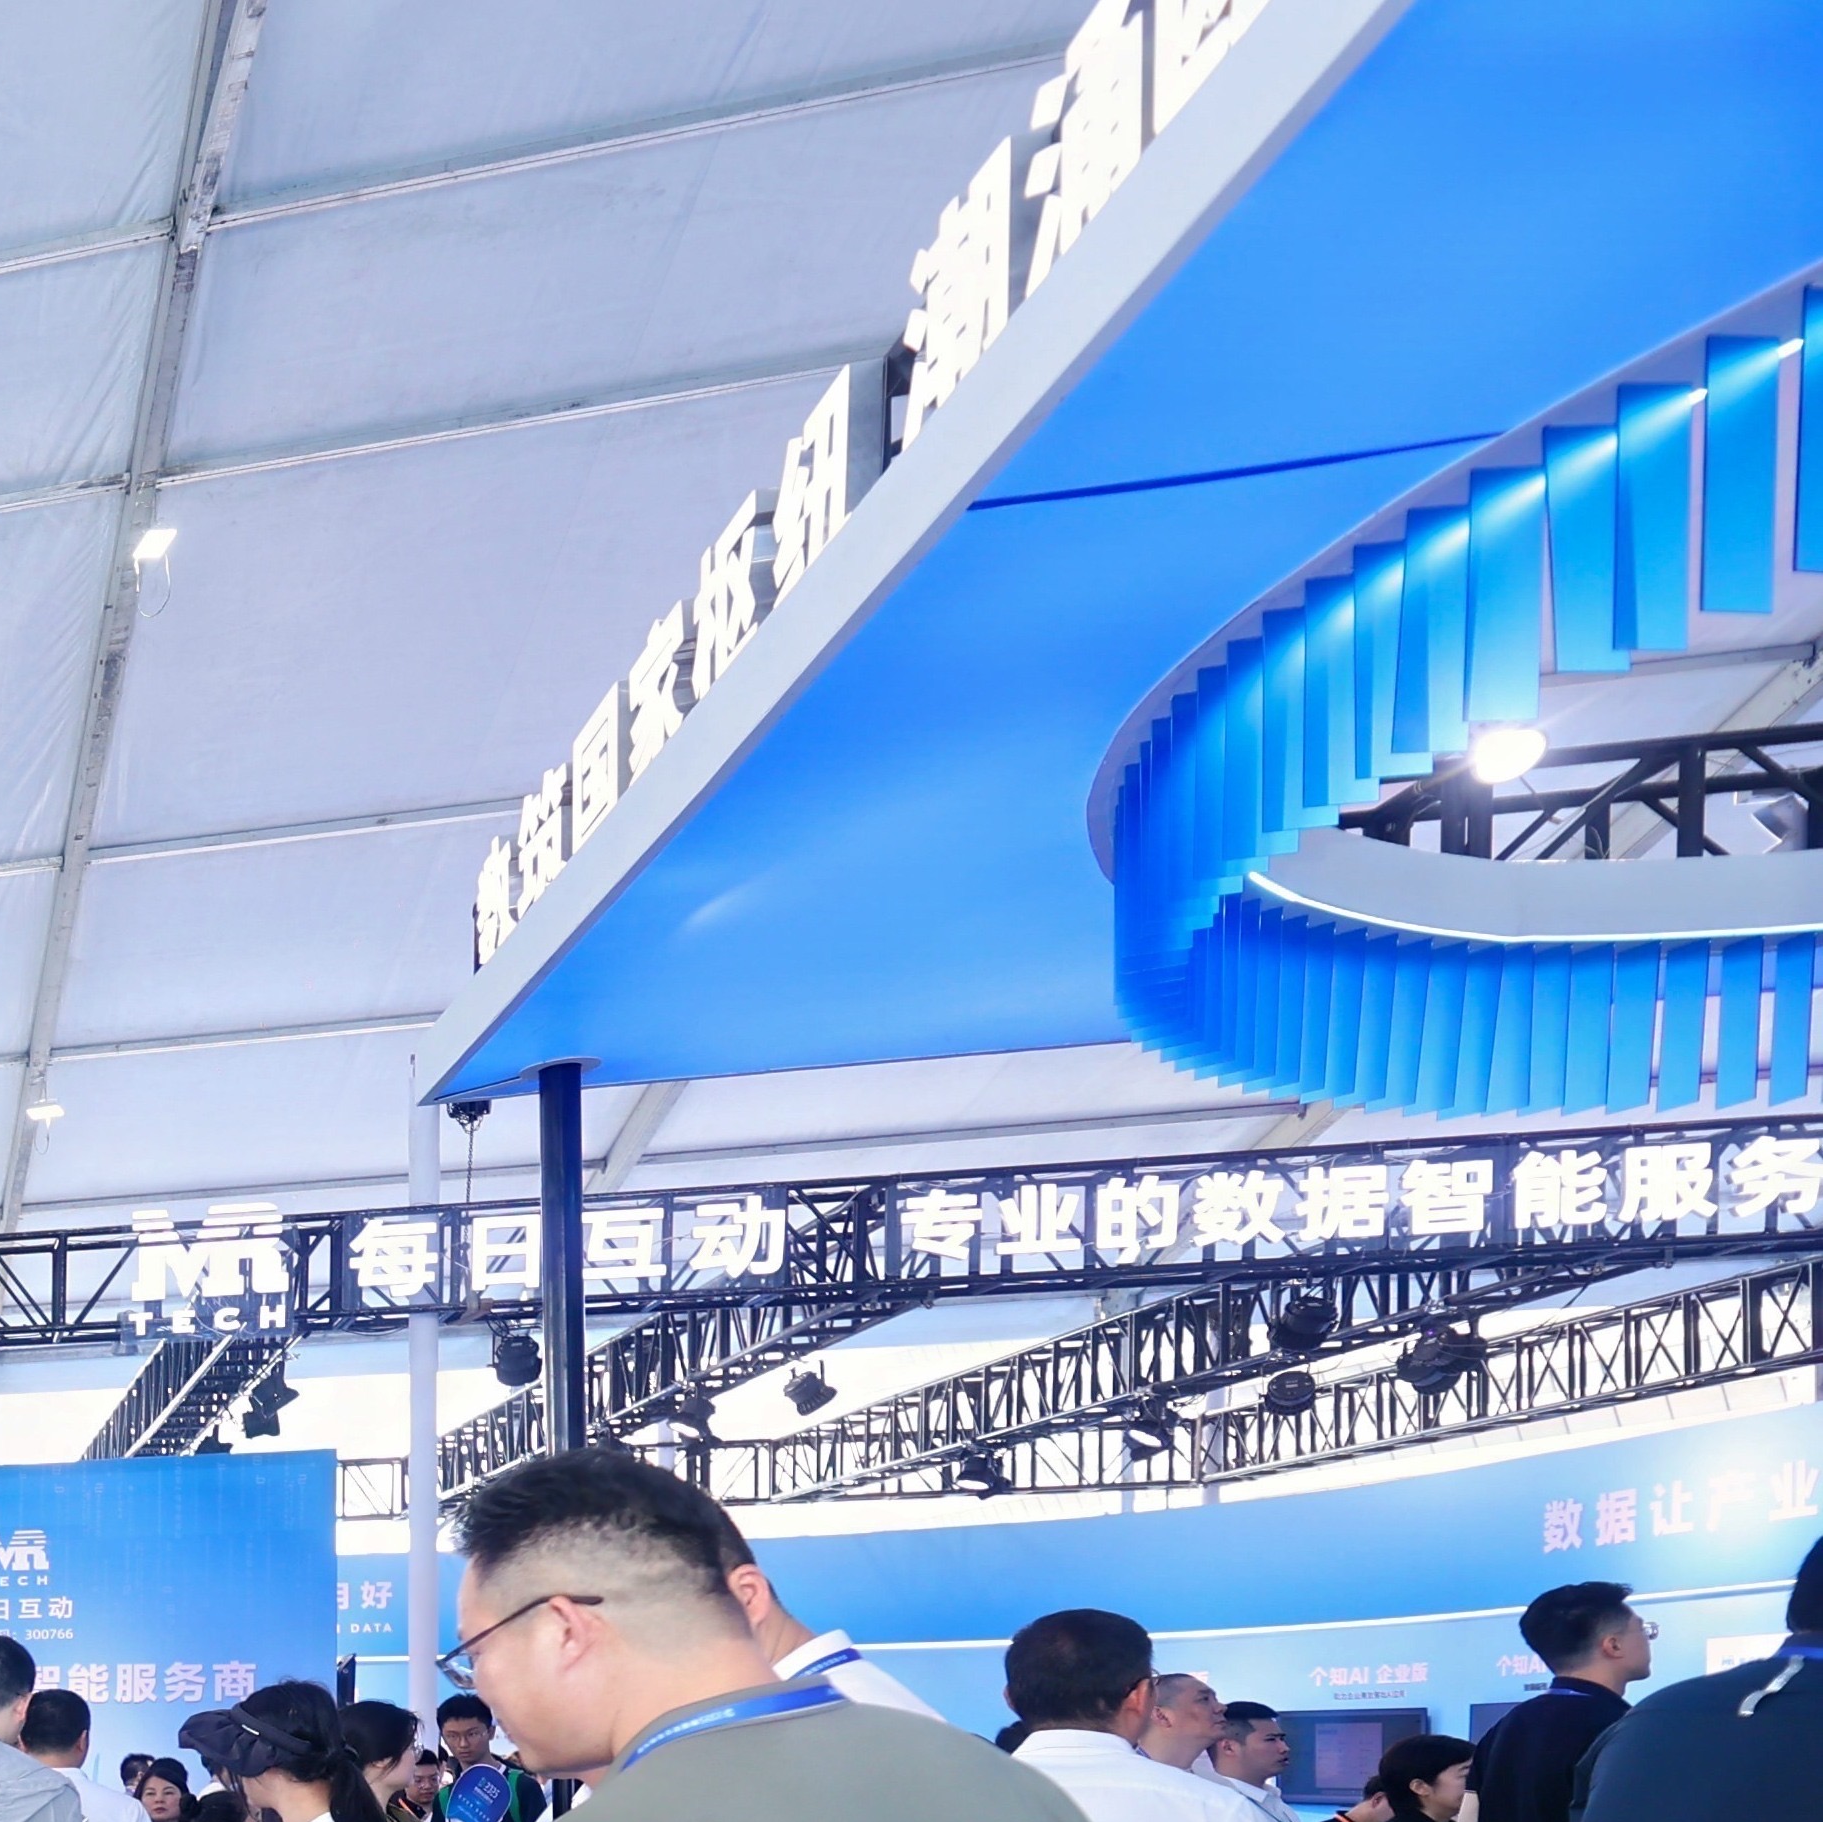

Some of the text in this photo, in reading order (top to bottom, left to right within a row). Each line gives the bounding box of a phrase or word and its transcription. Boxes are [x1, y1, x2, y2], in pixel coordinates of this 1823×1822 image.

[349, 1135, 1823, 1298] 每日互动 专业的数据智能服务
[128, 1304, 287, 1337] TECH
[1543, 1460, 1819, 1554] 数据让产业
[350, 1622, 393, 1634] DATA
